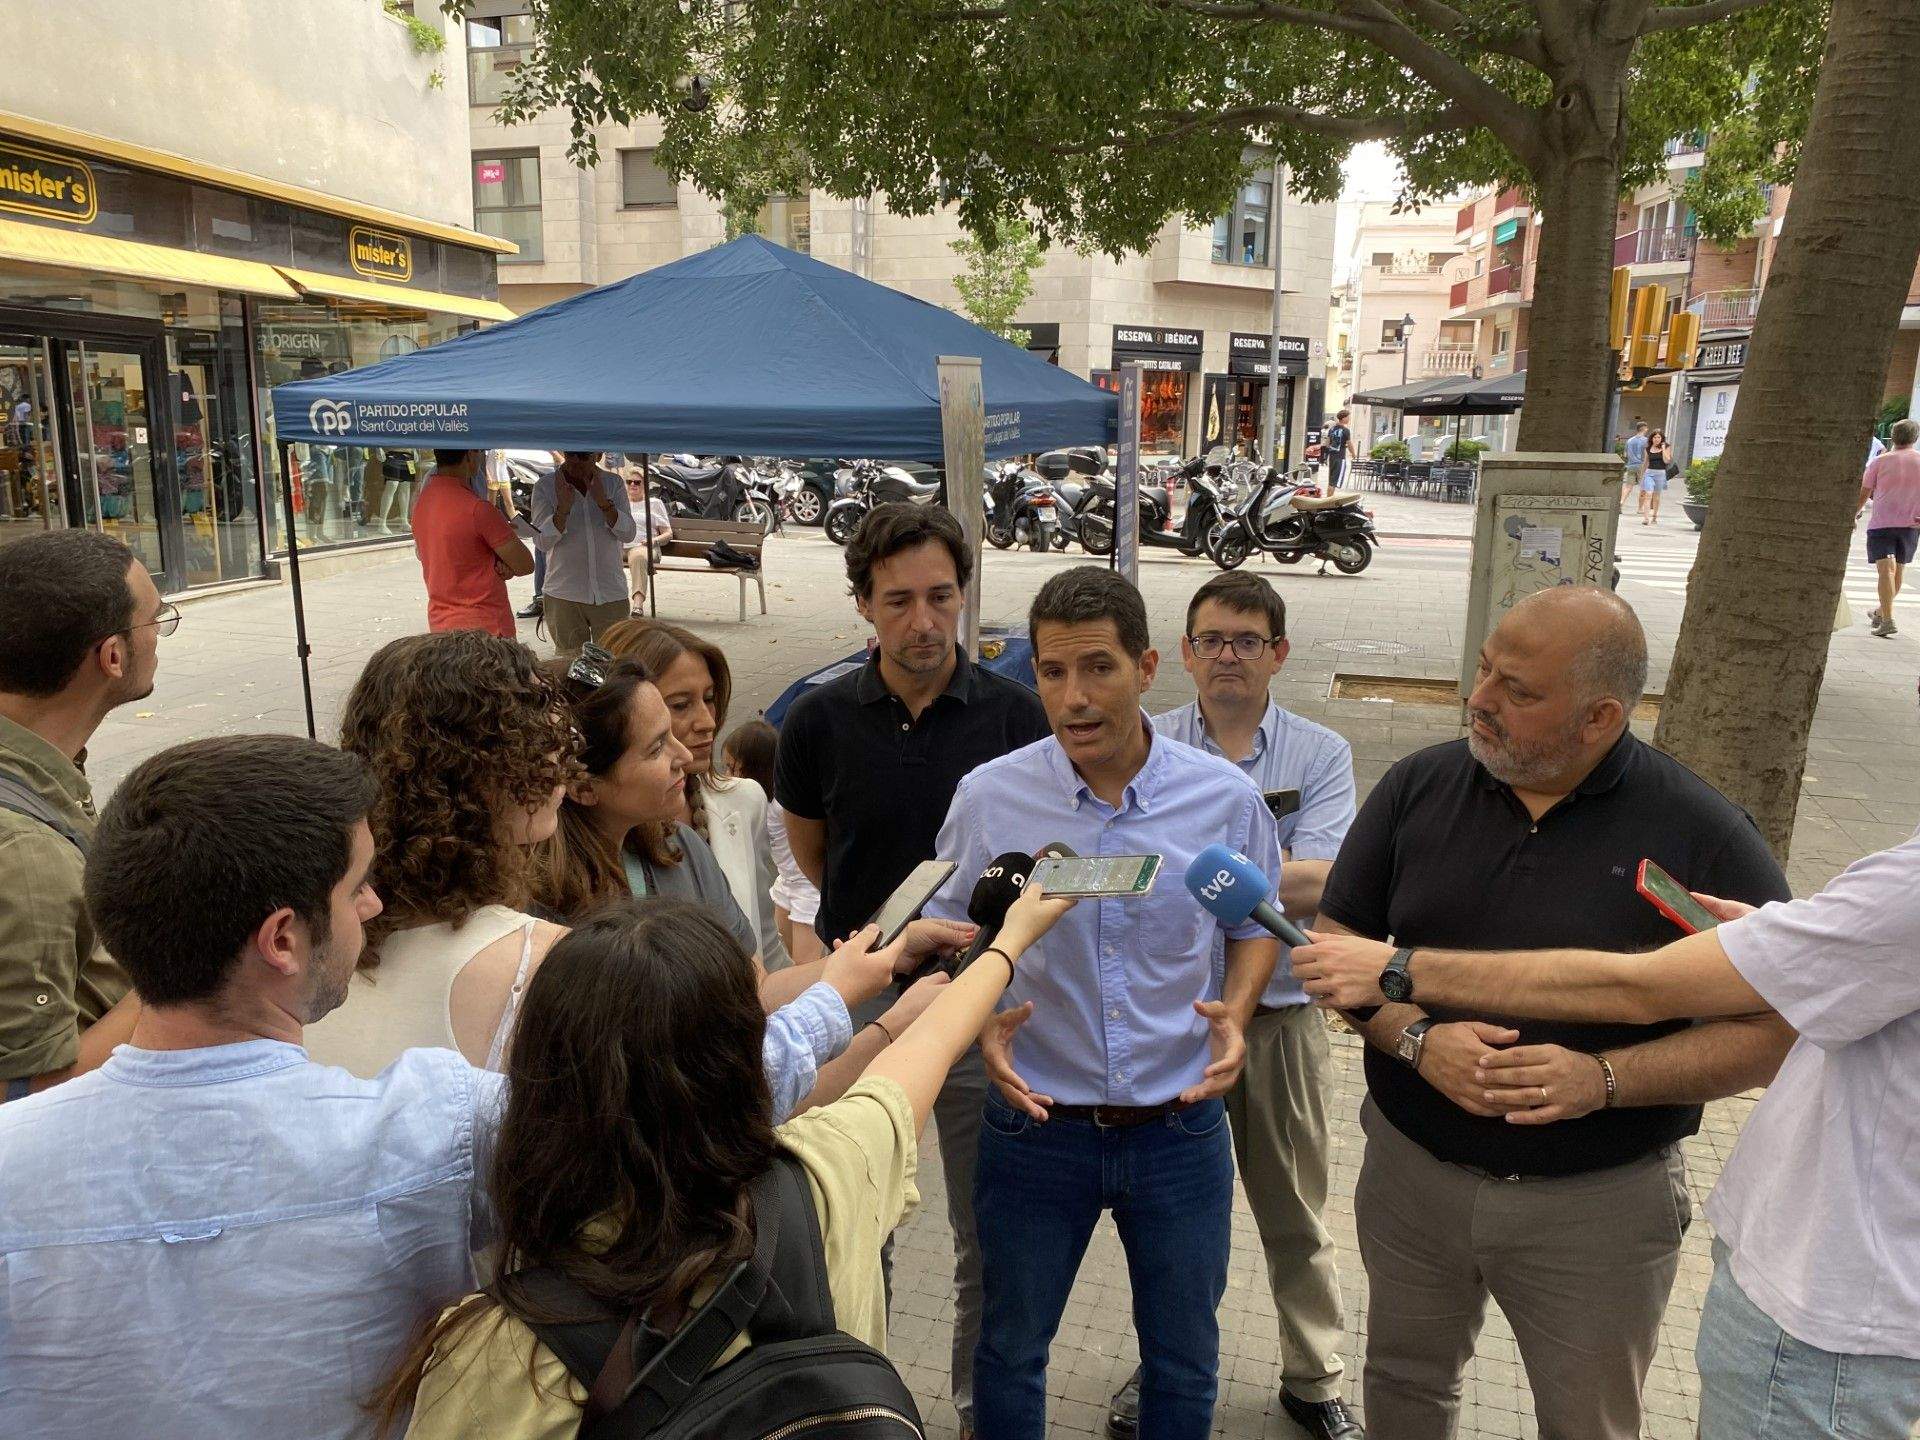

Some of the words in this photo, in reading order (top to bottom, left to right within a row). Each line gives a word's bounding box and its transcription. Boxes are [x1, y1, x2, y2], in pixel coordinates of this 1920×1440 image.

[357, 243, 406, 267] mister's
[1117, 330, 1153, 343] RESERVA
[1164, 333, 1199, 346] IBÉRICA
[1234, 337, 1265, 349] RESERVA
[1278, 341, 1305, 351] BÉRICA
[358, 404, 409, 417] PARTIDO
[410, 404, 468, 417] POPULAR
[360, 419, 386, 432] Sant
[385, 420, 418, 435] Cugat
[419, 419, 435, 432] del
[437, 419, 469, 432] Vallès
[1705, 419, 1727, 431] LOCAL
[1200, 869, 1236, 901] tve
